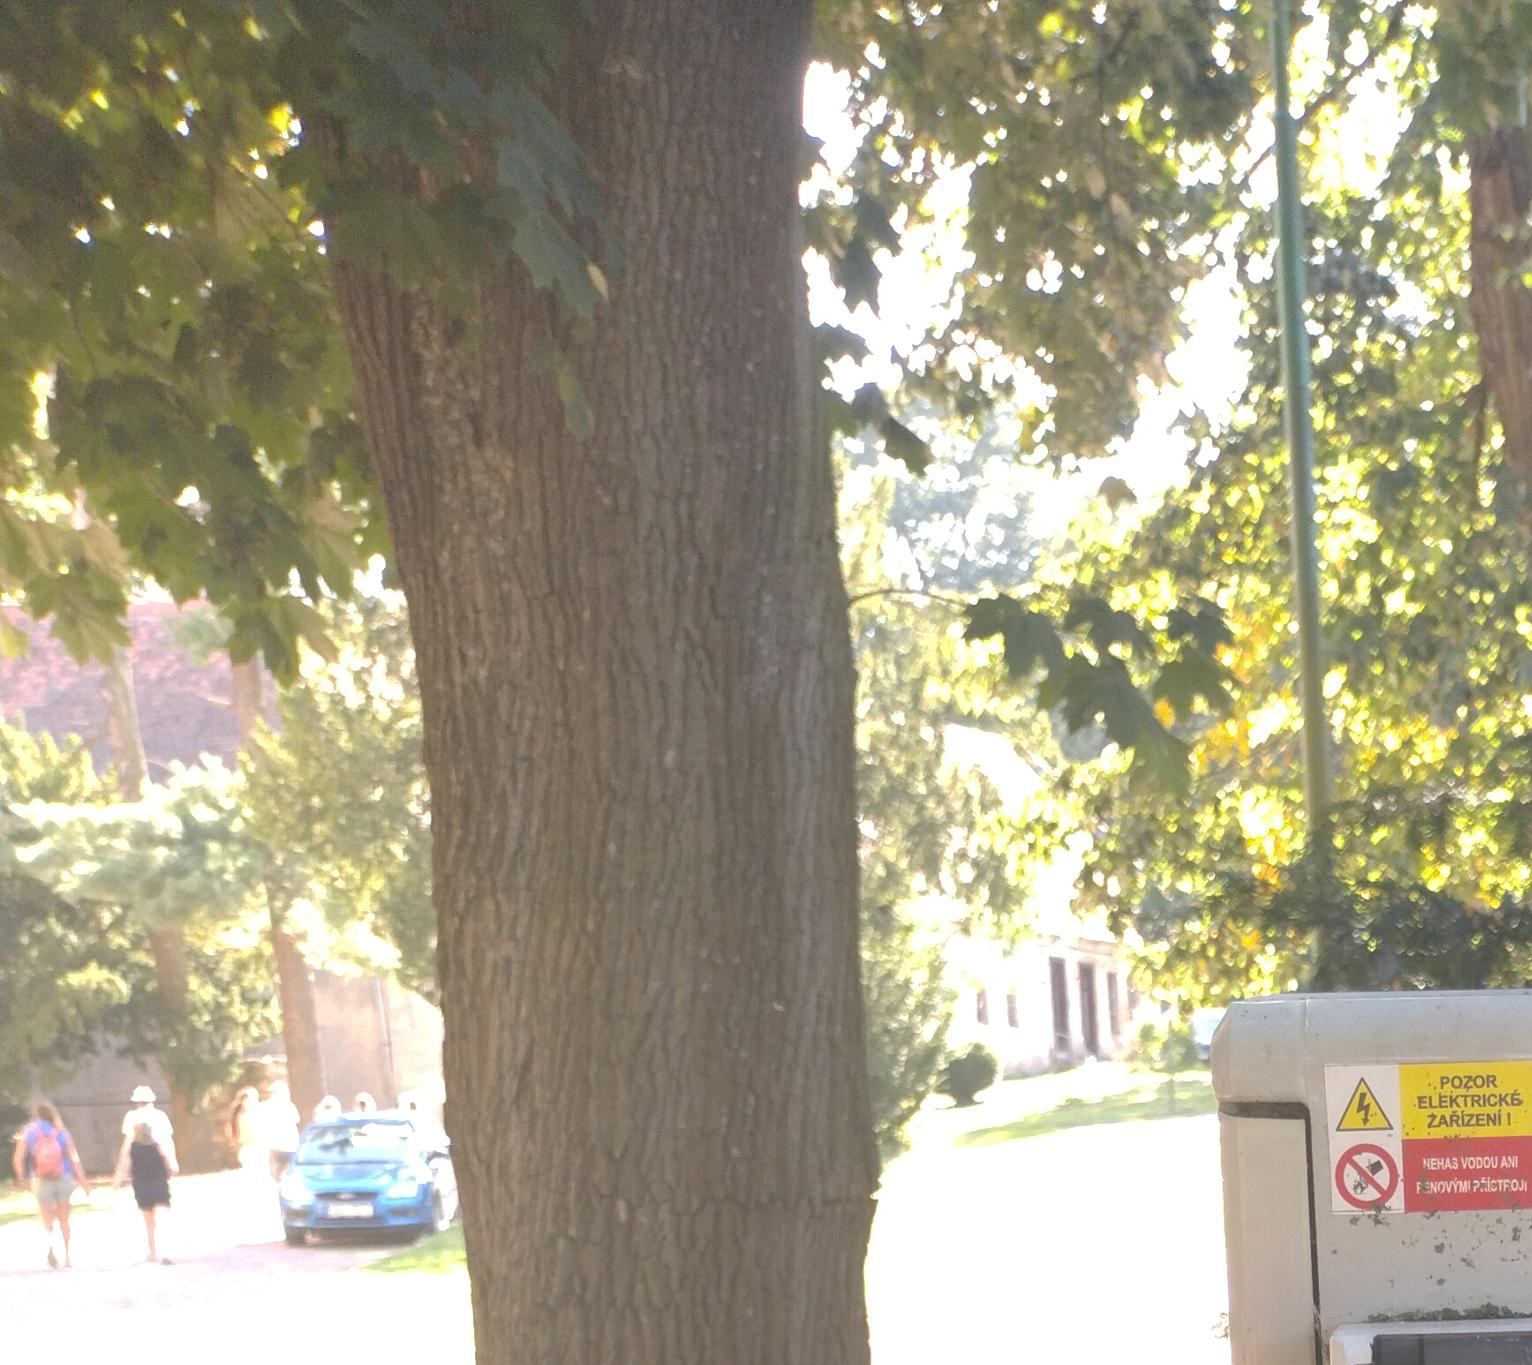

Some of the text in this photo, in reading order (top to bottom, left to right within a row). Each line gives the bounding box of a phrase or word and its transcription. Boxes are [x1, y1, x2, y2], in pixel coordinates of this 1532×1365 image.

[1439, 1074, 1498, 1090] POZOR
[1417, 1088, 1523, 1110] ELEKTRICKÉ
[1427, 1108, 1512, 1129] ZAŘÍZENÍ !
[1423, 1155, 1518, 1171] NEHAS VODOU ANI
